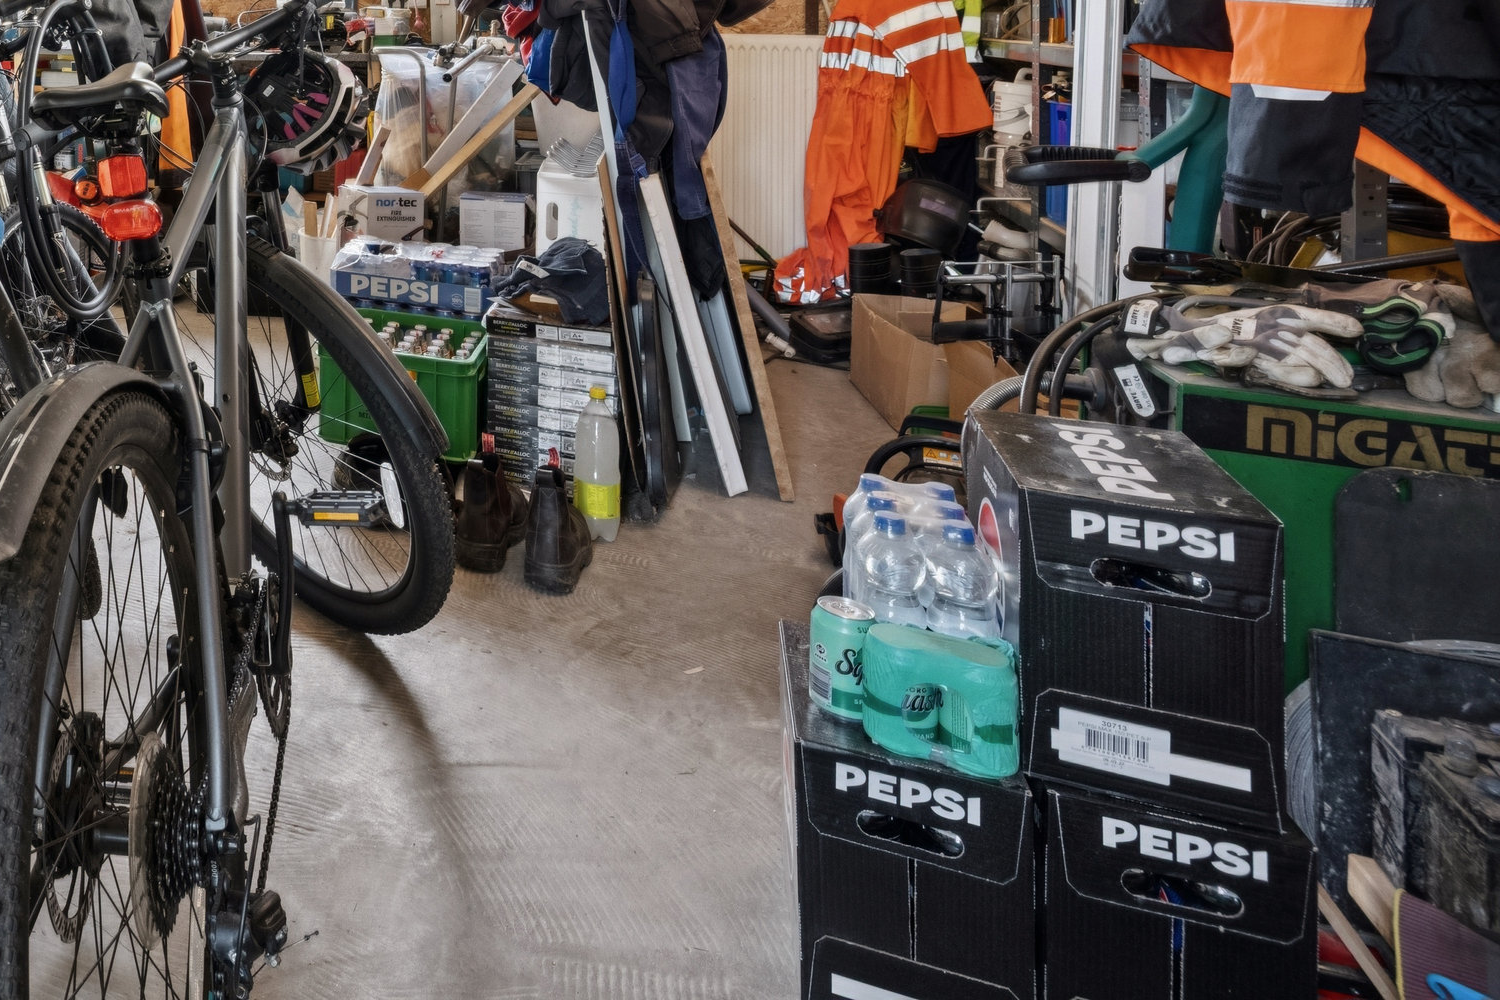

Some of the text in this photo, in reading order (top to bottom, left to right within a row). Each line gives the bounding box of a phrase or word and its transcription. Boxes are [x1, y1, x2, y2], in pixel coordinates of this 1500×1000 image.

[350, 274, 439, 305] PEPSI
[1052, 423, 1176, 501] PEPSI
[1071, 509, 1236, 563] PEPSI
[1101, 720, 1128, 732] 30713
[835, 762, 981, 827] PEPSI
[1102, 816, 1269, 882] PEPSI
